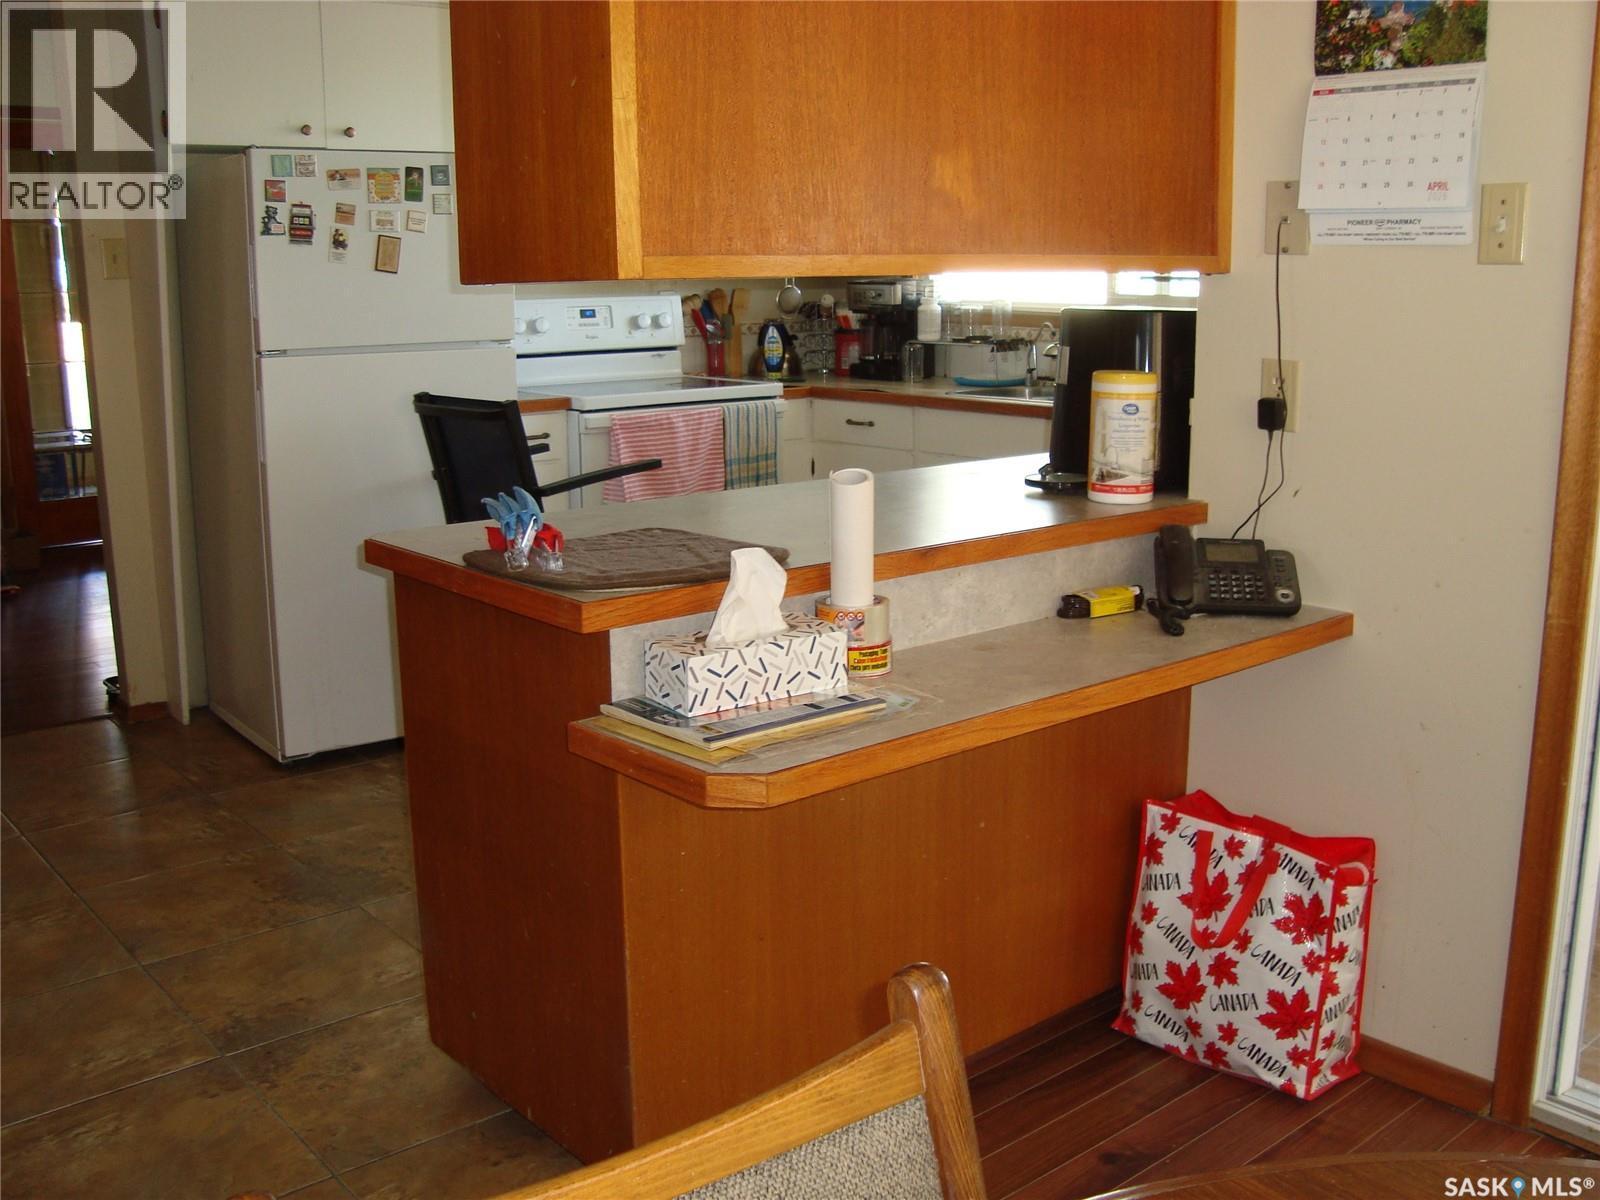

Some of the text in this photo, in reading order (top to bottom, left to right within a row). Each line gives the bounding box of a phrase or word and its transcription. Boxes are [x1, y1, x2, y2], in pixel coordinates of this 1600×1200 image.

[1426, 180, 1449, 192] APRIL
[1386, 218, 1422, 226] PHARMACY
[1178, 825, 1224, 869] CADA
[1278, 847, 1315, 891] ANADA
[1156, 916, 1196, 960] CANADA
[1250, 944, 1302, 987] CANADA
[1144, 1004, 1189, 1042] CANADA
[1209, 992, 1259, 1012] CANADA
[1237, 1036, 1287, 1078] CANADA
